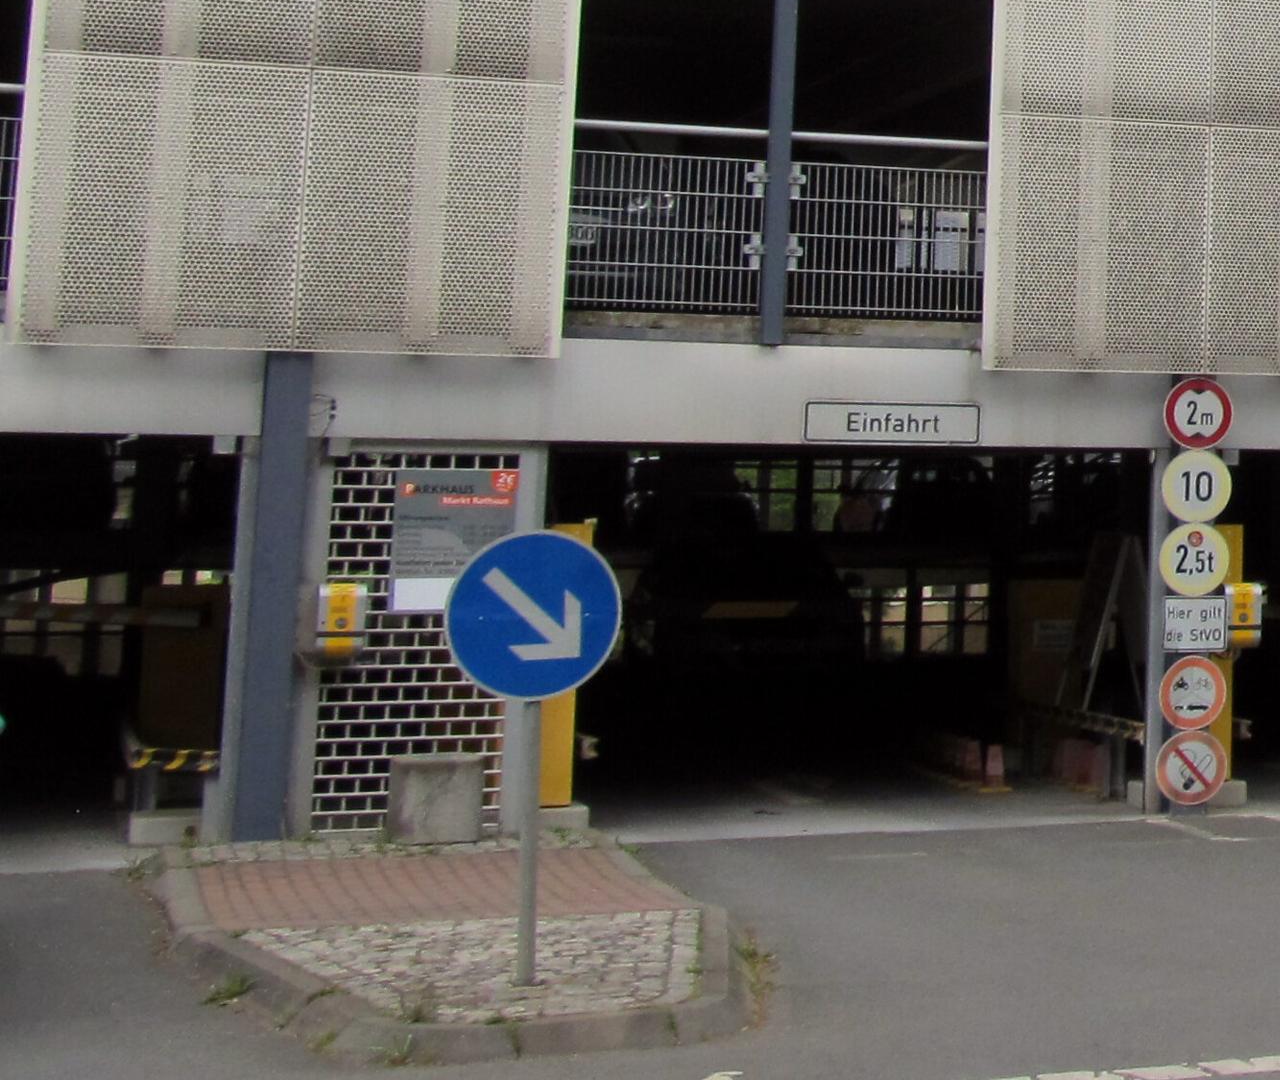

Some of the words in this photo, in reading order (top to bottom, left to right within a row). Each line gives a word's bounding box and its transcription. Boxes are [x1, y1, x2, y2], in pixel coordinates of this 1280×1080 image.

[846, 411, 941, 434] Einfahrt
[1186, 400, 1198, 426] 2
[1200, 411, 1214, 426] m
[405, 482, 475, 495] PARKHAUS
[1180, 471, 1214, 502] 10
[1167, 606, 1192, 619] Hier
[1200, 605, 1222, 622] gilt
[1166, 628, 1183, 642] die
[1190, 628, 1222, 642] StVO
